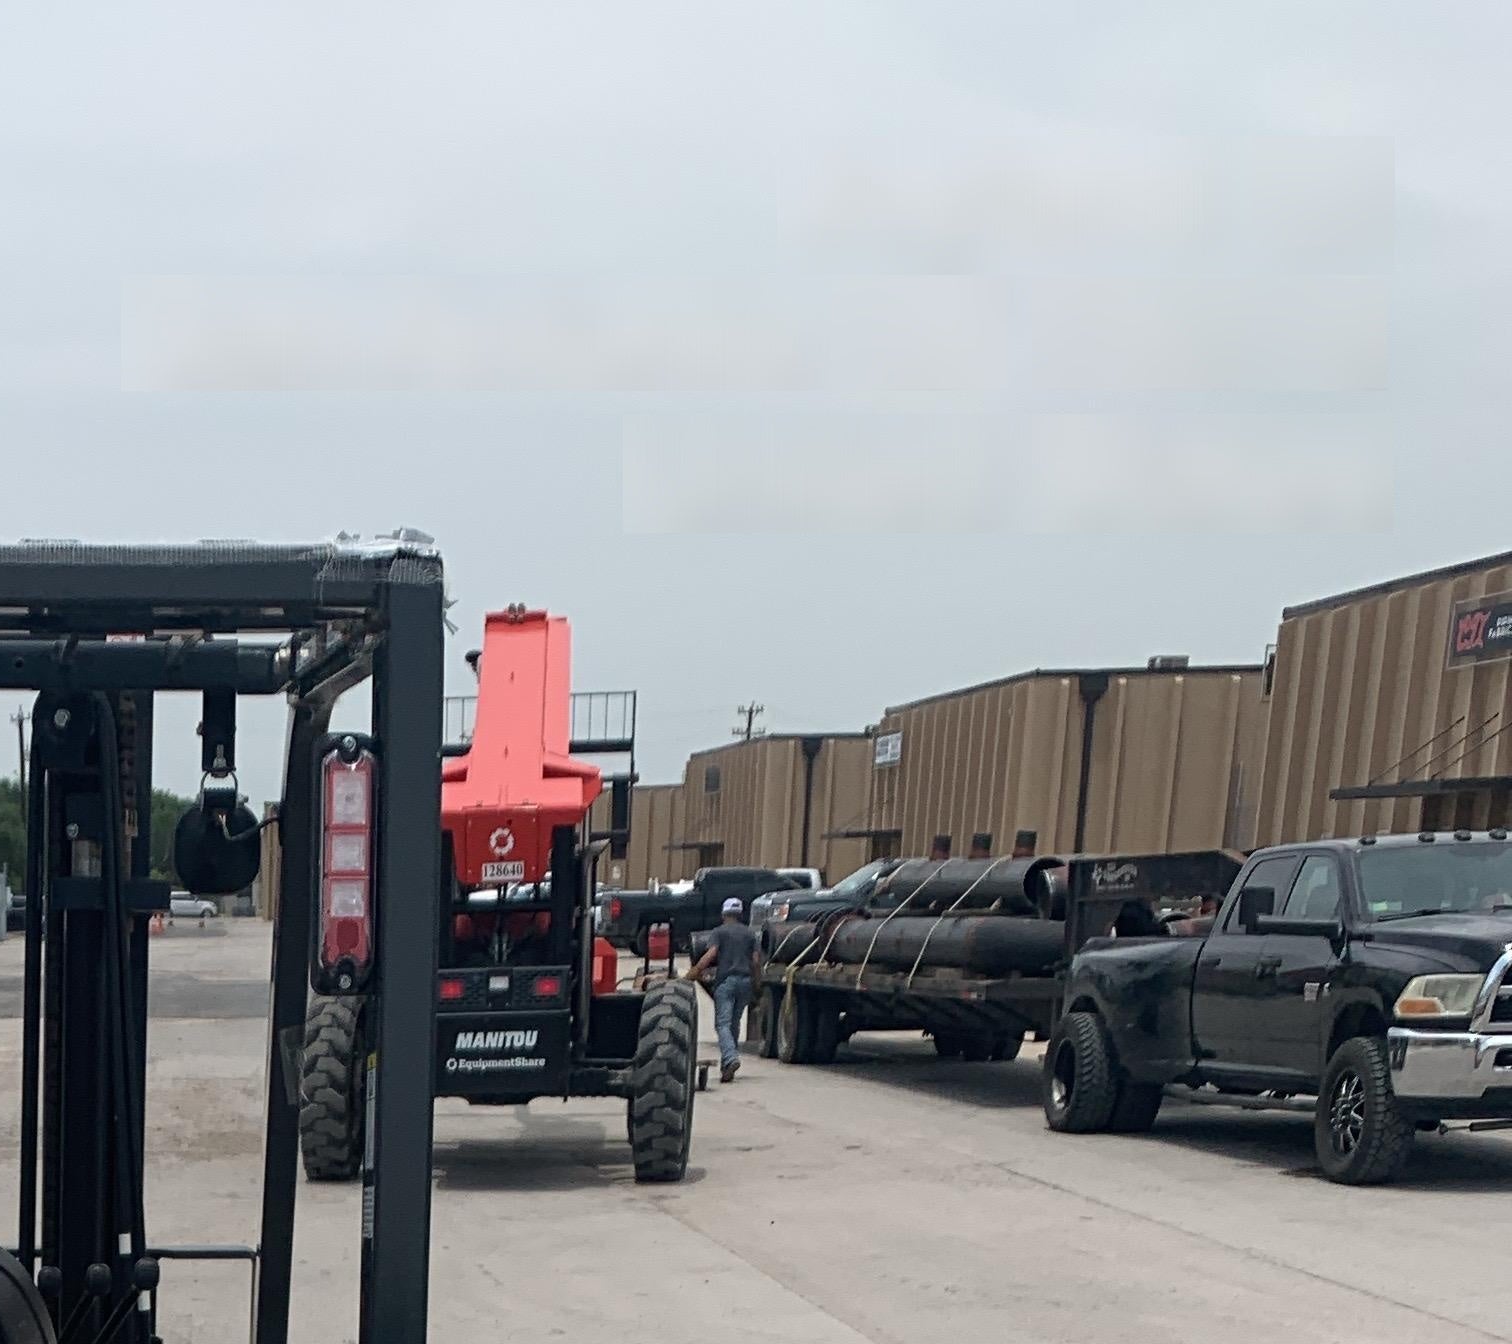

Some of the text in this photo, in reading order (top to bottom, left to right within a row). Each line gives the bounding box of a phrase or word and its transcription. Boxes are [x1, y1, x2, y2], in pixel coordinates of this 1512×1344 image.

[483, 863, 523, 877] 128640
[455, 1030, 539, 1049] MANITOU
[458, 1056, 546, 1070] EquipmentShare
